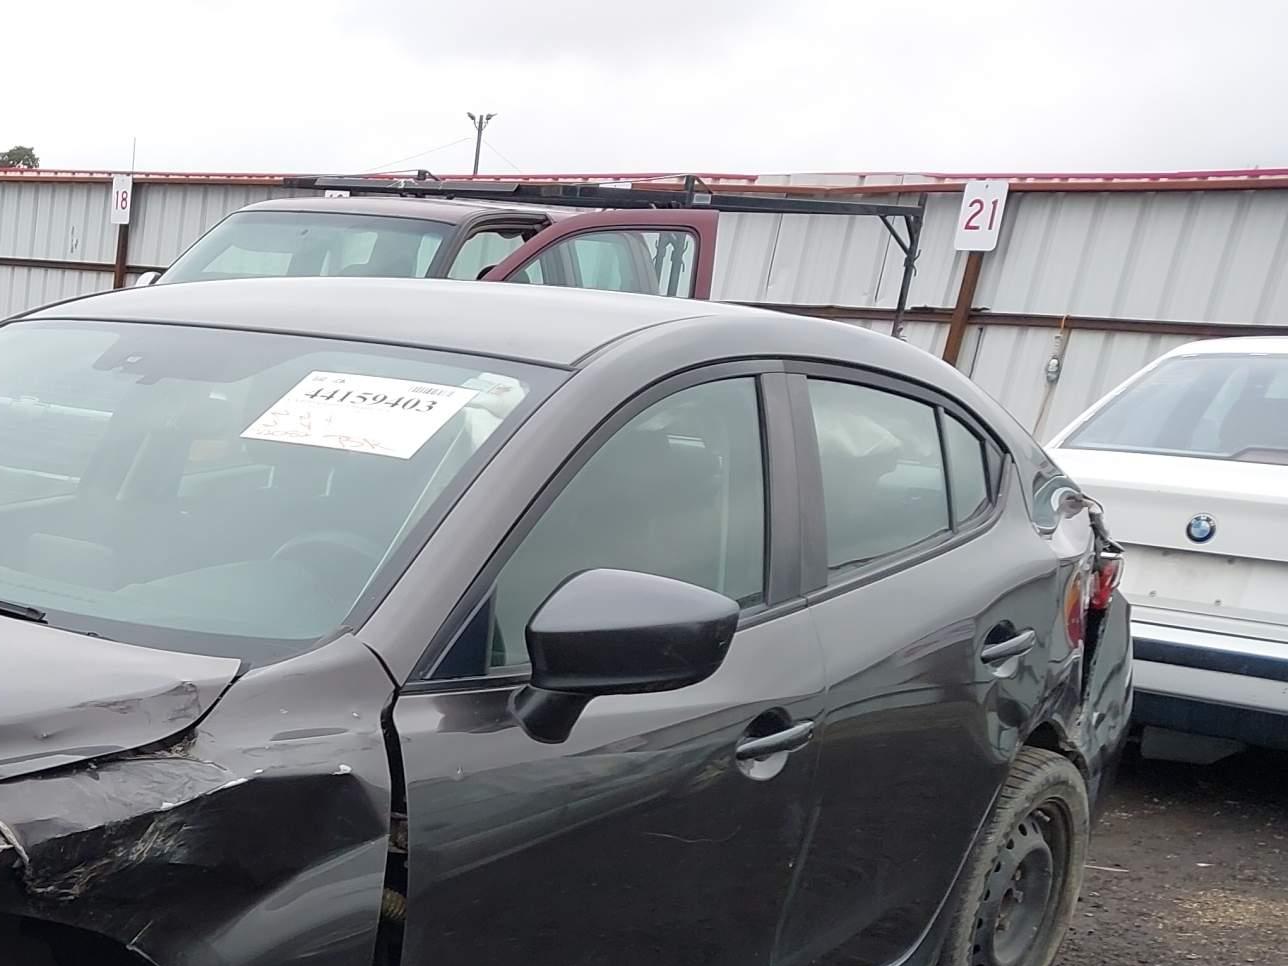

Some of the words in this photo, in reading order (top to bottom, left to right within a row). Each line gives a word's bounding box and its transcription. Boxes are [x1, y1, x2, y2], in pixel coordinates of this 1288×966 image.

[115, 190, 128, 210] 18
[964, 198, 999, 231] 21
[304, 387, 438, 413] 44159403
